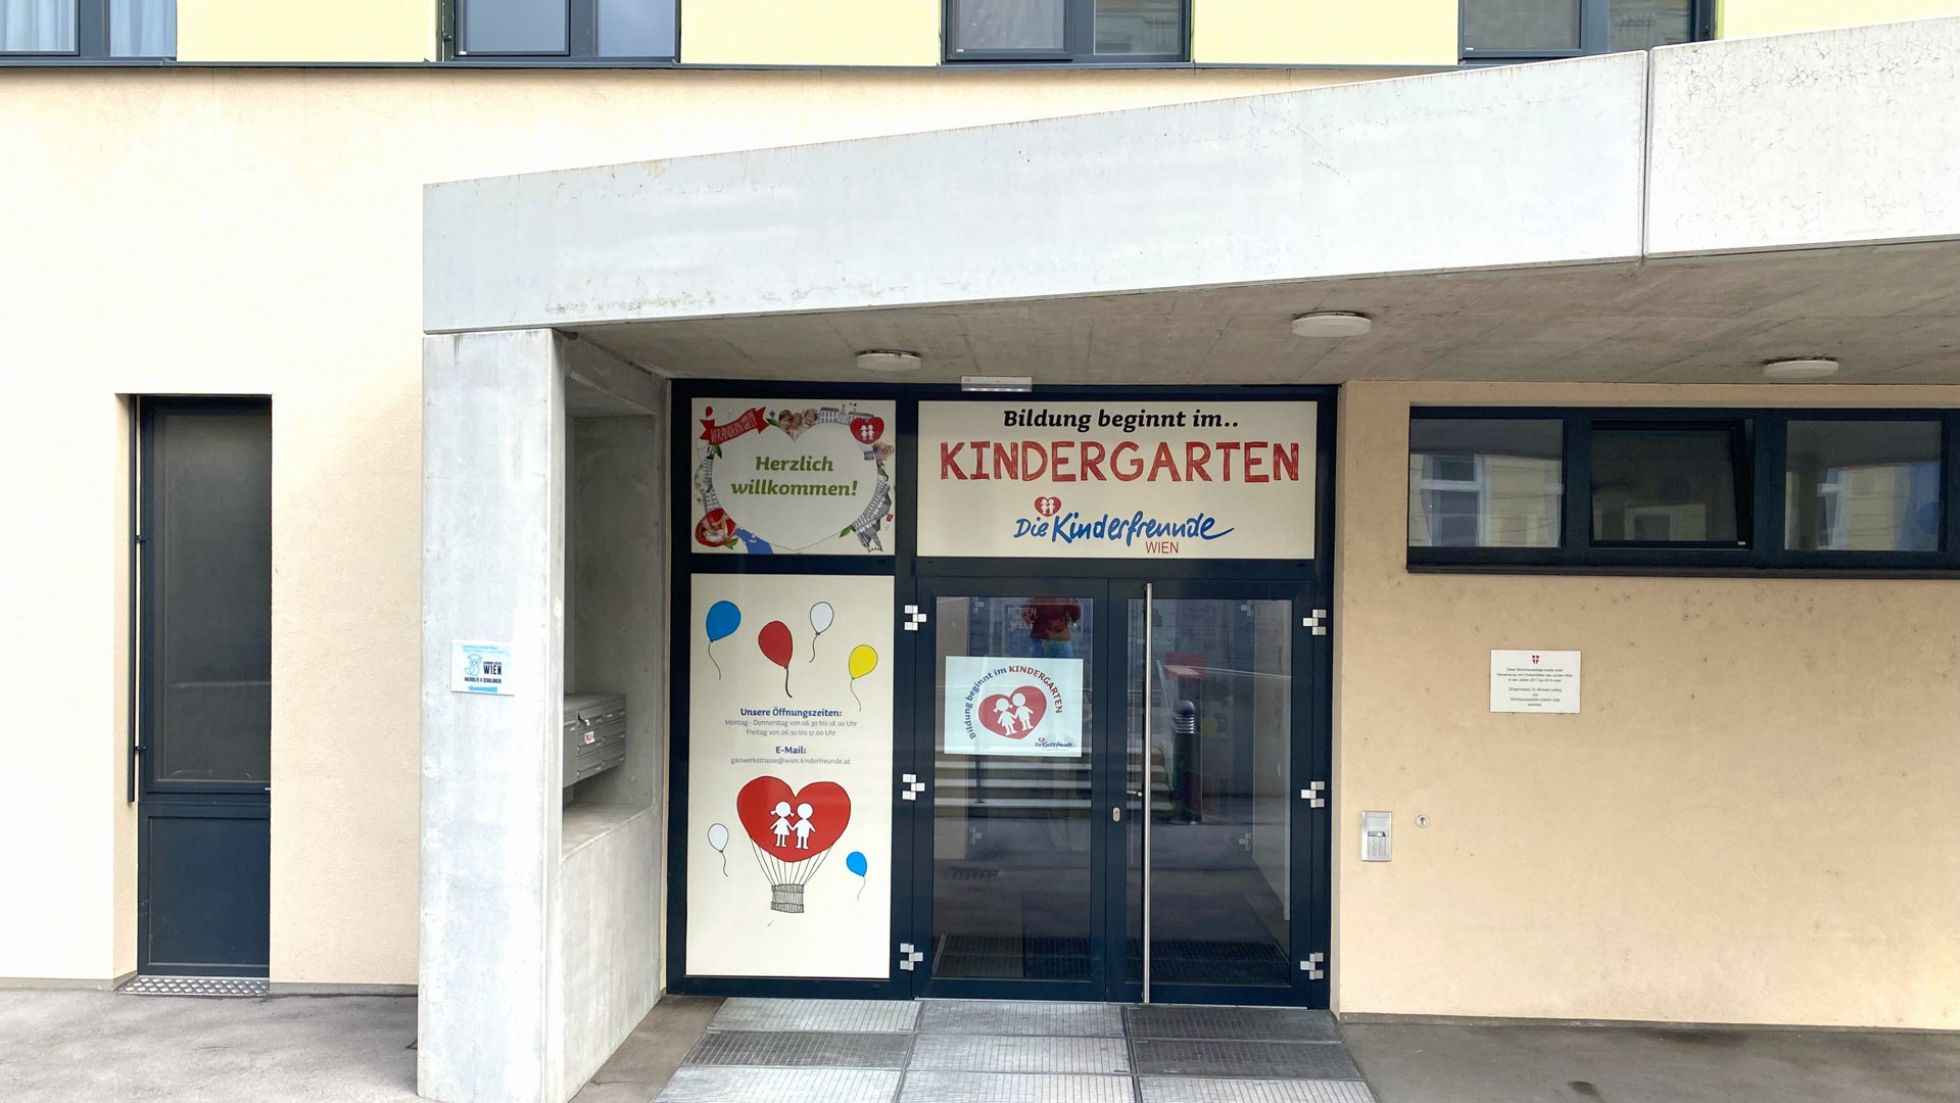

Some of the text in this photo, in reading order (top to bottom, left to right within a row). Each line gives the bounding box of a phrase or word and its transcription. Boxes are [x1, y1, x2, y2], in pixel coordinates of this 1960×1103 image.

[1003, 409, 1239, 433] Bildung beginnt im..
[755, 456, 834, 472] Herzlich
[940, 440, 1300, 483] KINDERGARTEN
[731, 479, 858, 497] willkommen!
[1013, 510, 1236, 547] Die Kinderfreunde
[1145, 541, 1180, 555] WIEN
[483, 664, 502, 675] WIEN
[964, 665, 1063, 740] Bildung beginnt im KINDERGARTEN
[740, 706, 842, 719] Unsere Öffnungszeiten:
[724, 719, 748, 727] Montag
[753, 719, 788, 727] Donnerstag
[745, 728, 768, 736] Freitag
[775, 745, 807, 754] E-Mail:
